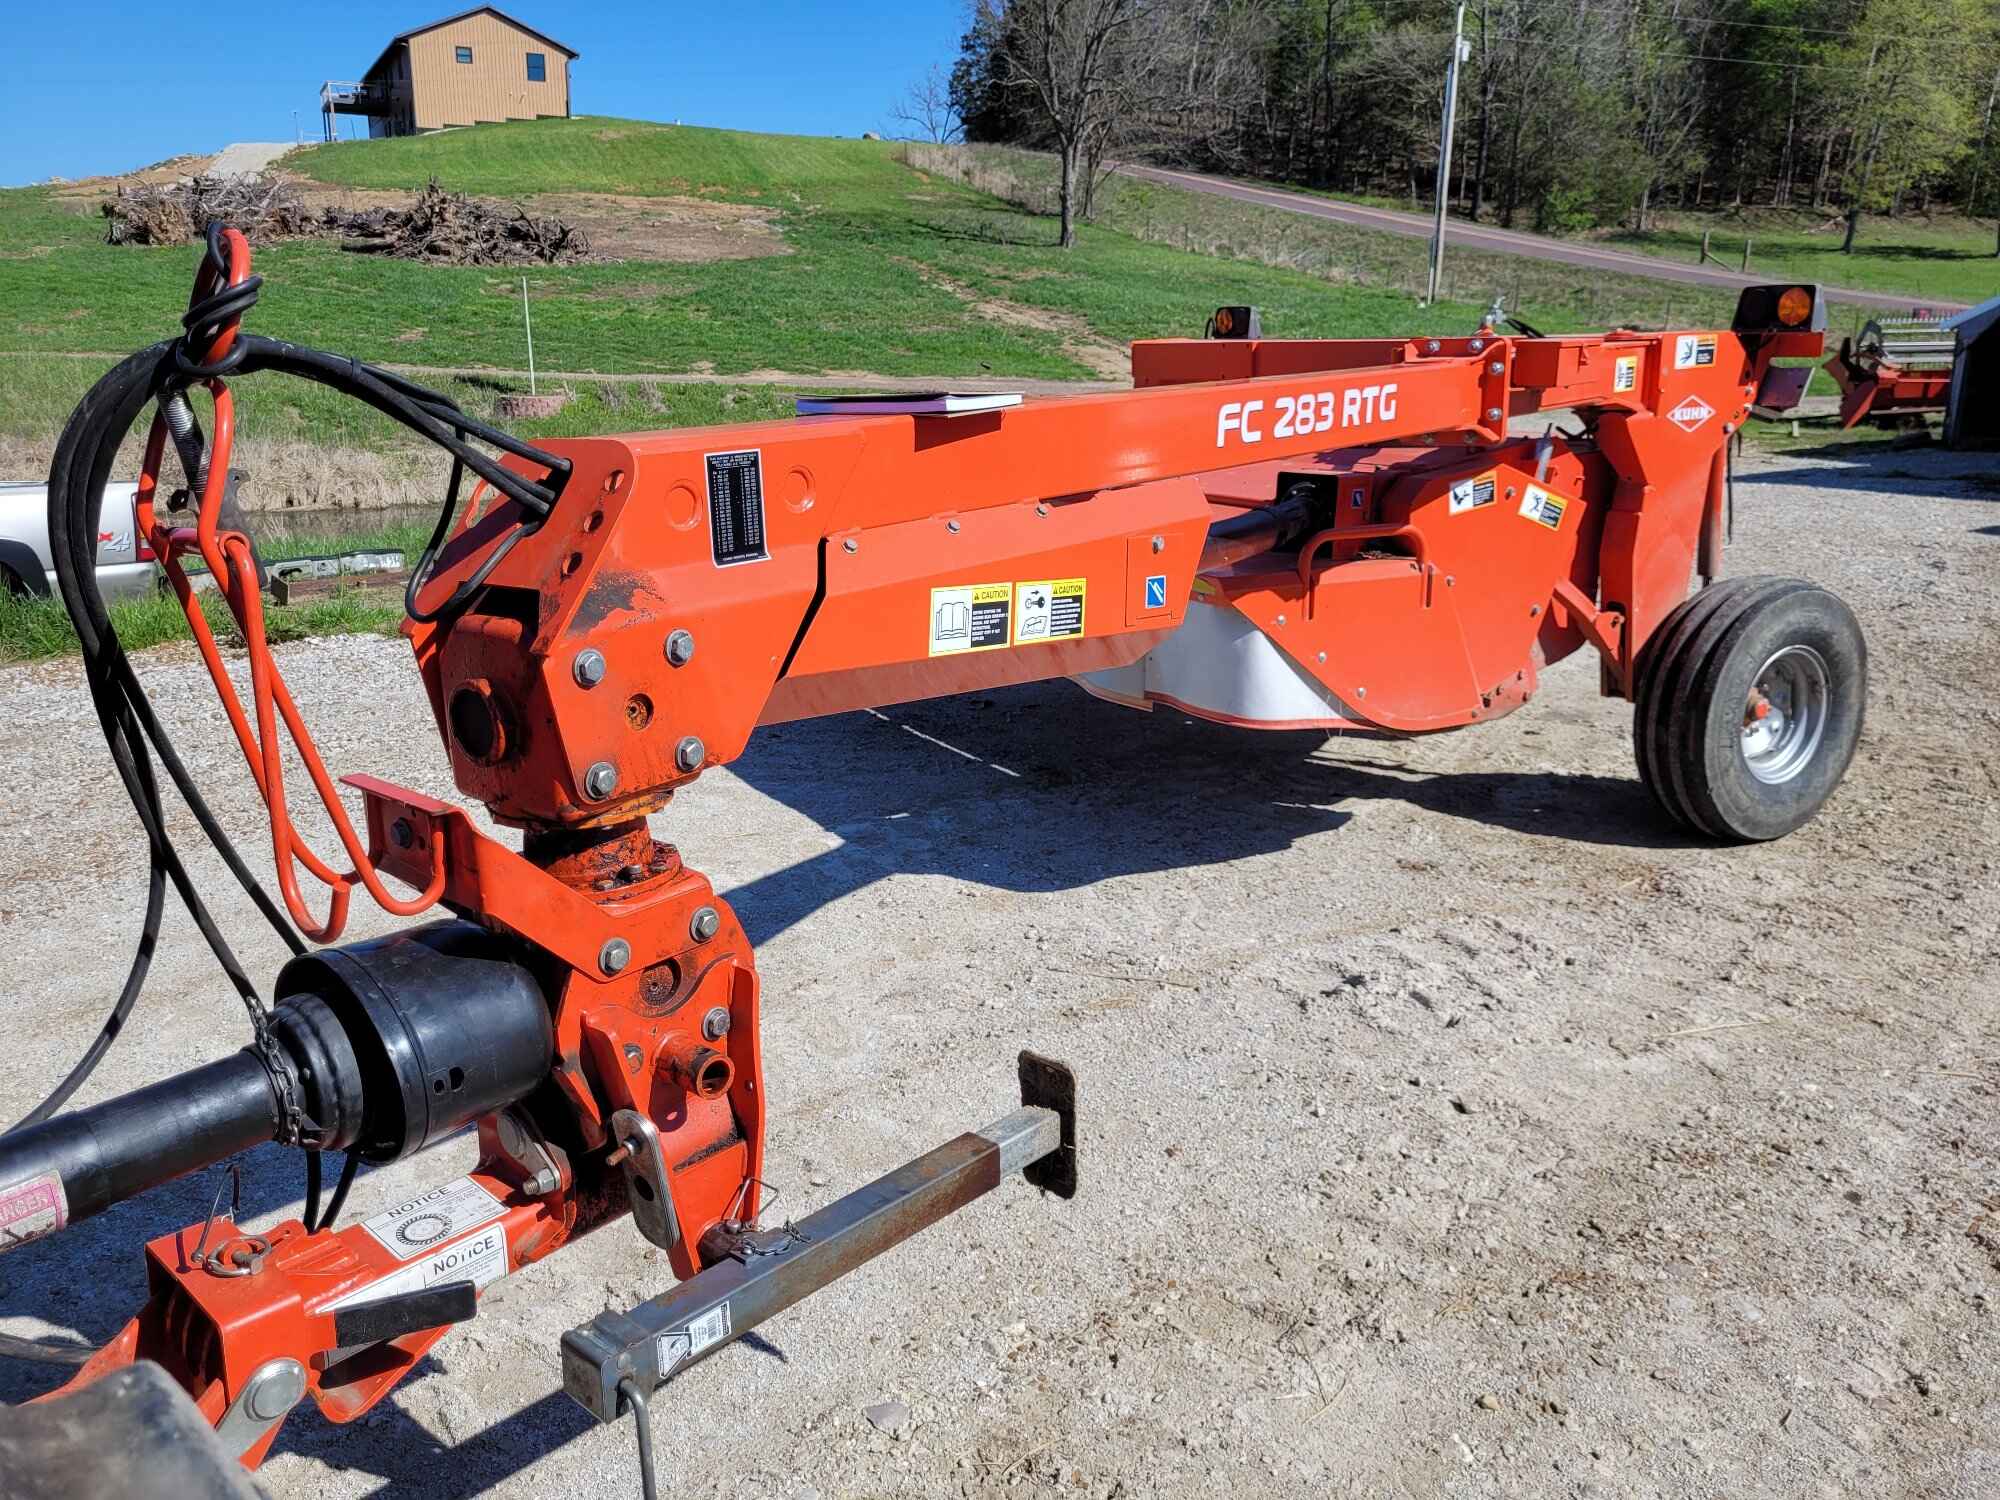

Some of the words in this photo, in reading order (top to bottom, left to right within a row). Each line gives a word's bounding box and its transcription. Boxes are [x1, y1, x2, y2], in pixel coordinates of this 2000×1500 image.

[1216, 399, 1264, 447] FC
[1273, 391, 1335, 438] 283
[1341, 383, 1397, 427] RTG
[1674, 406, 1707, 421] KUHN
[981, 588, 1009, 600] CAUTION
[1058, 583, 1083, 595] CAUTION
[387, 1186, 451, 1218] NOTICE
[433, 1235, 496, 1276] NOTICE
